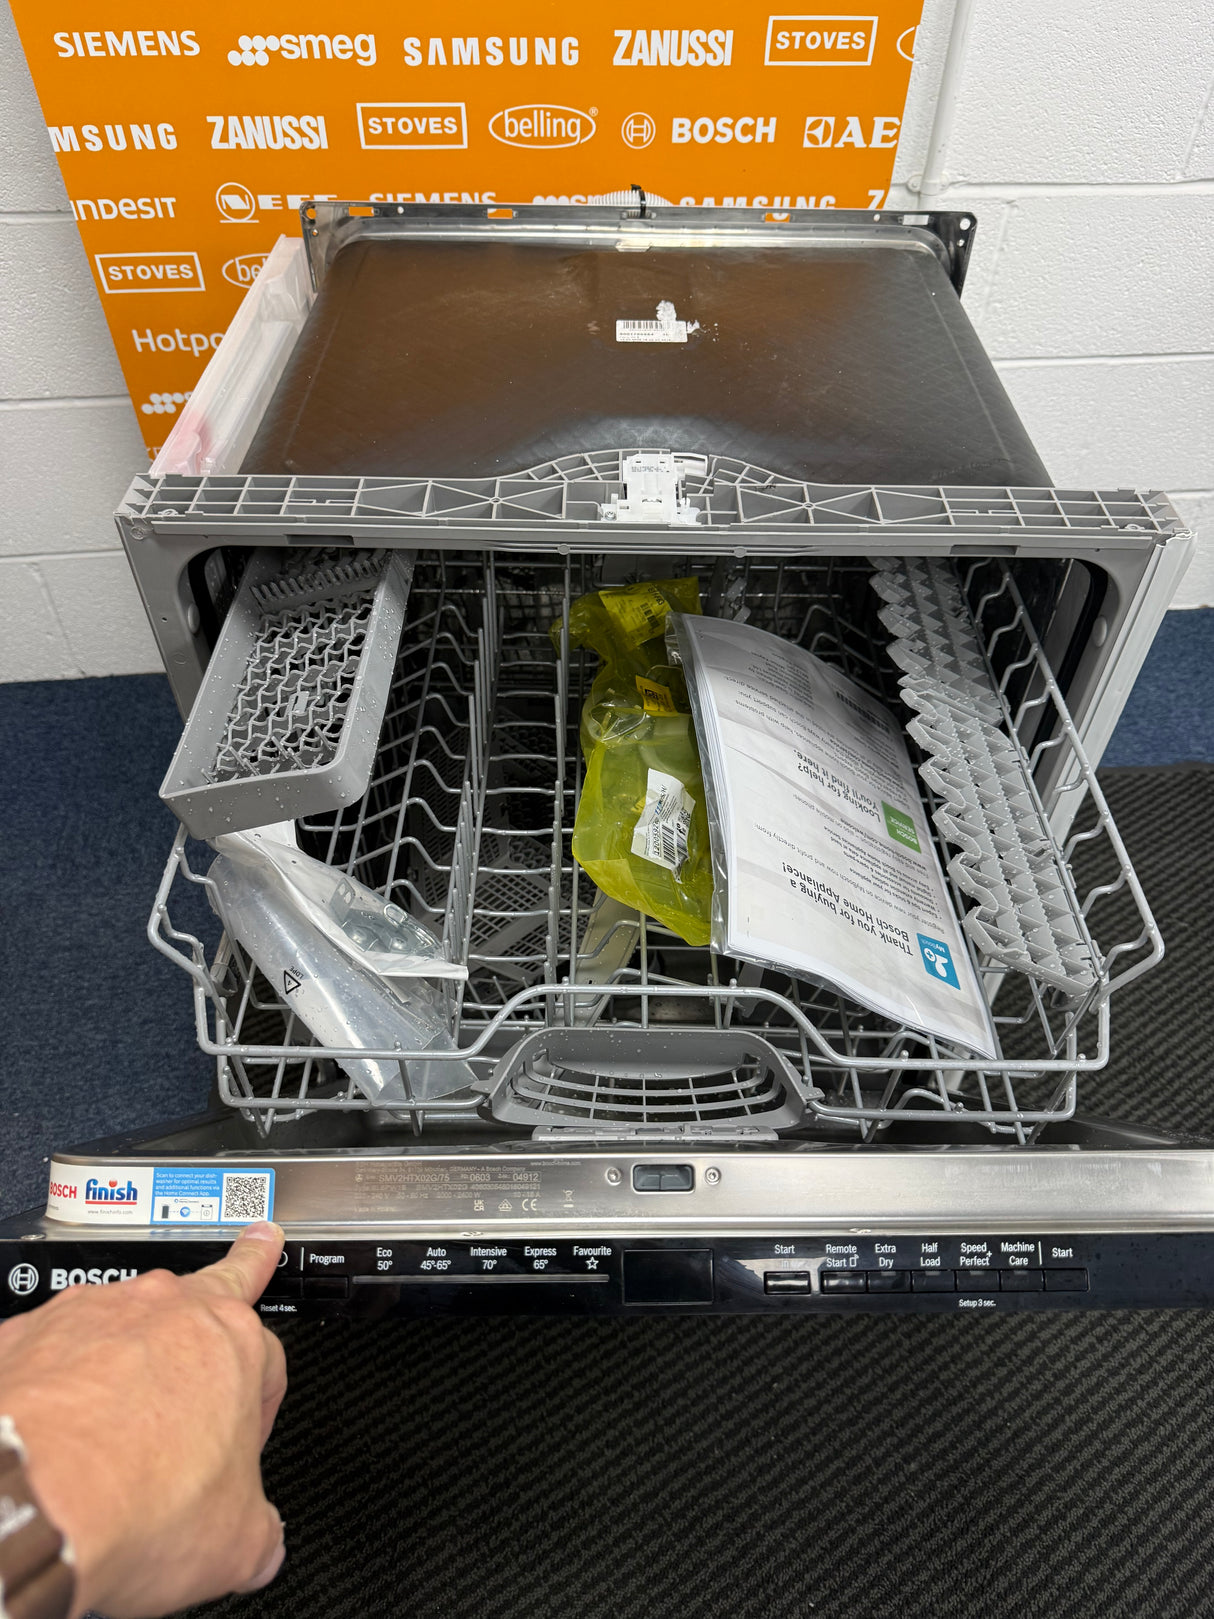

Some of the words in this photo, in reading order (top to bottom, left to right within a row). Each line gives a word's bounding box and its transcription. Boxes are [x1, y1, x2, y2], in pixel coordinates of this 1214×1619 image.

[54, 31, 200, 58] SIEMENS
[776, 31, 866, 50] STOVES
[280, 33, 377, 66] smeg
[404, 36, 579, 66] SAMSUNG
[613, 29, 734, 67] ZANUSSI
[368, 117, 457, 135] STOVES
[504, 109, 581, 145] belling
[671, 117, 776, 144] BOSCH
[206, 115, 328, 150] ZANUSSI
[108, 264, 194, 281] STOVES
[793, 749, 819, 773] here.
[796, 761, 824, 786] help?
[821, 767, 829, 779] it
[826, 780, 841, 797] for
[830, 773, 850, 793] find
[842, 790, 880, 822] Looking
[852, 788, 878, 812] You'll
[782, 861, 840, 904] Appliance!
[789, 877, 796, 889] a
[799, 881, 836, 914] buying
[838, 907, 855, 925] for
[842, 896, 873, 924] Home
[856, 917, 876, 936] you
[875, 917, 909, 942] Bosch
[878, 930, 912, 955] Thank
[469, 1173, 491, 1181] 0603
[512, 1173, 539, 1181] 04912
[85, 1178, 138, 1201] finish
[376, 1247, 393, 1257] Eco
[426, 1247, 447, 1257] Auto
[470, 1246, 507, 1257] Intensive
[524, 1246, 557, 1258] Express
[573, 1246, 612, 1256] Favourite
[774, 1244, 795, 1254] Start
[825, 1244, 857, 1254] Remote
[874, 1243, 896, 1253] Extra
[921, 1242, 938, 1252] Half
[960, 1242, 987, 1254] Speed
[1001, 1242, 1035, 1252] Machine
[1052, 1248, 1073, 1257] Start
[309, 1253, 345, 1264] Program
[377, 1259, 393, 1270] 50°
[482, 1259, 498, 1269] 70°
[533, 1259, 549, 1269] 65°
[826, 1258, 847, 1267] Start
[878, 1257, 893, 1268] Dry
[920, 1257, 941, 1267] Load
[1009, 1256, 1029, 1265] Care
[260, 1304, 278, 1312] Reset
[959, 1299, 977, 1308] Setup
